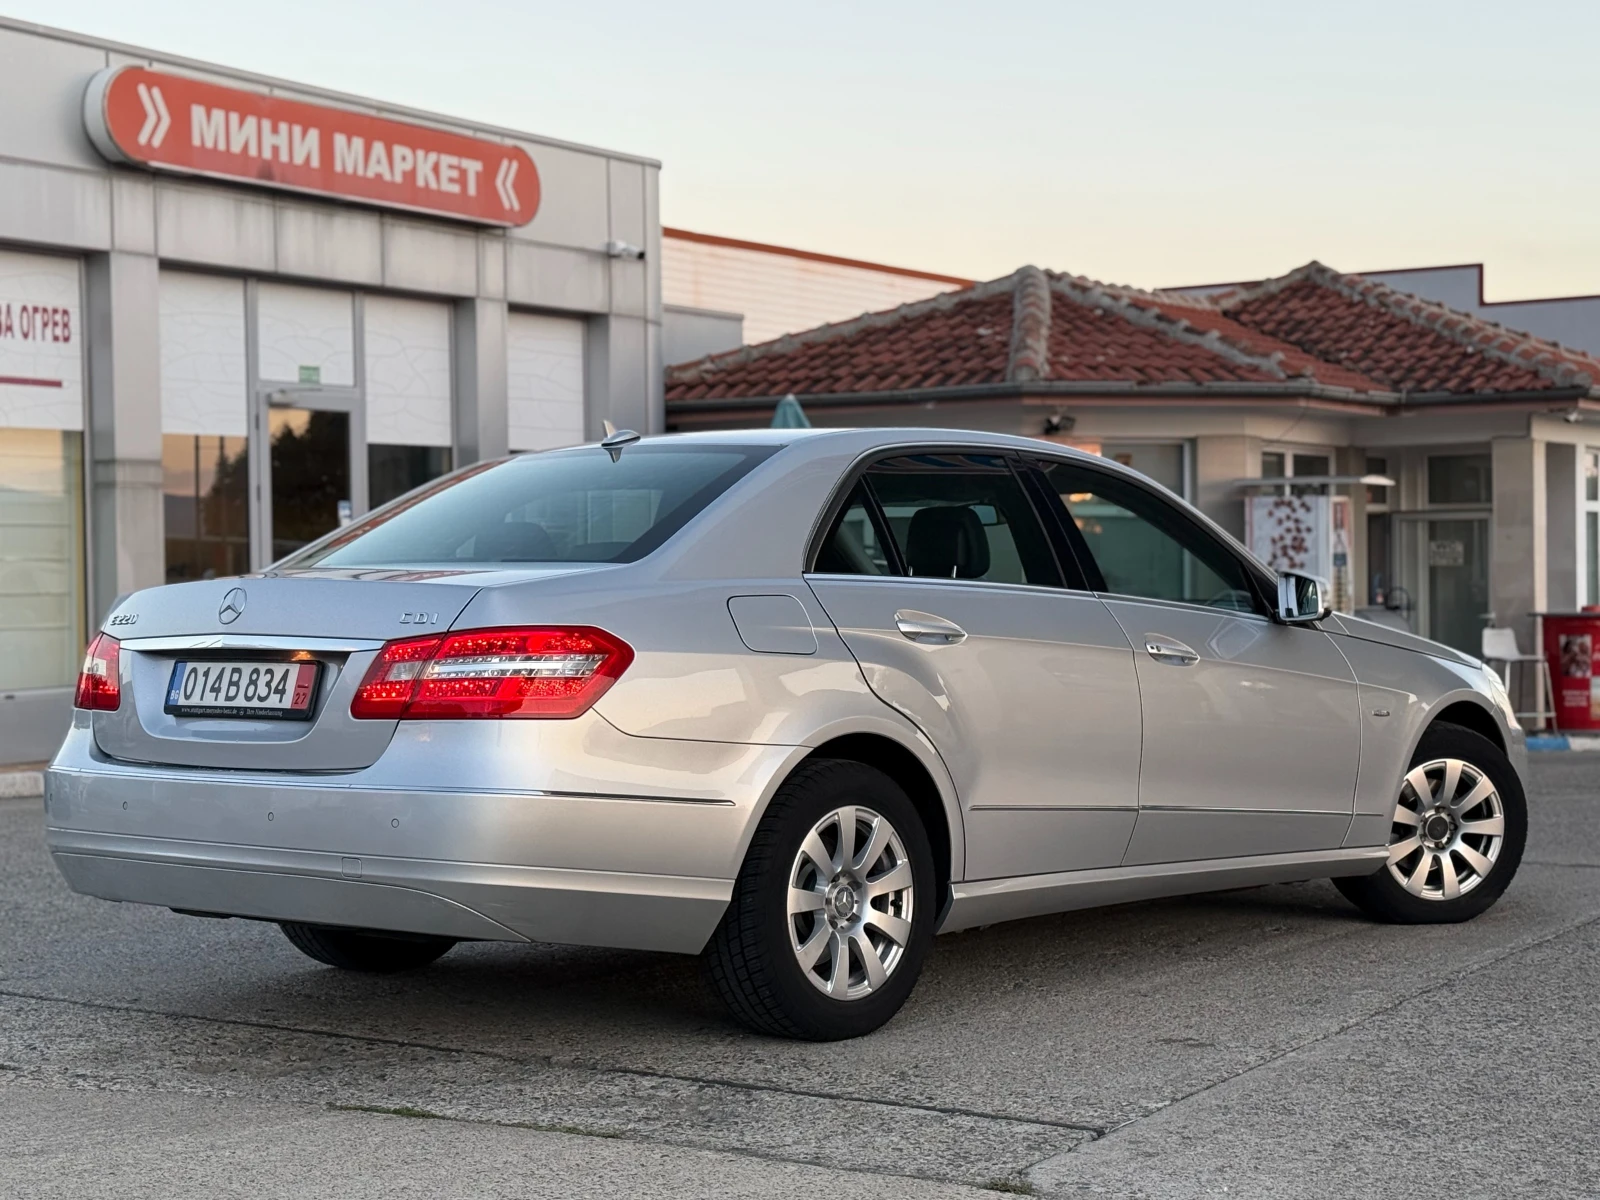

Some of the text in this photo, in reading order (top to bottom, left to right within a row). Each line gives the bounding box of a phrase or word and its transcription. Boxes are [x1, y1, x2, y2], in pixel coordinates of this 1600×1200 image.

[190, 104, 483, 196] МИНИ МАРКЕТ
[0, 303, 72, 343] А ОГРЕВ
[399, 612, 439, 624] CDI
[184, 667, 290, 703] 014B834
